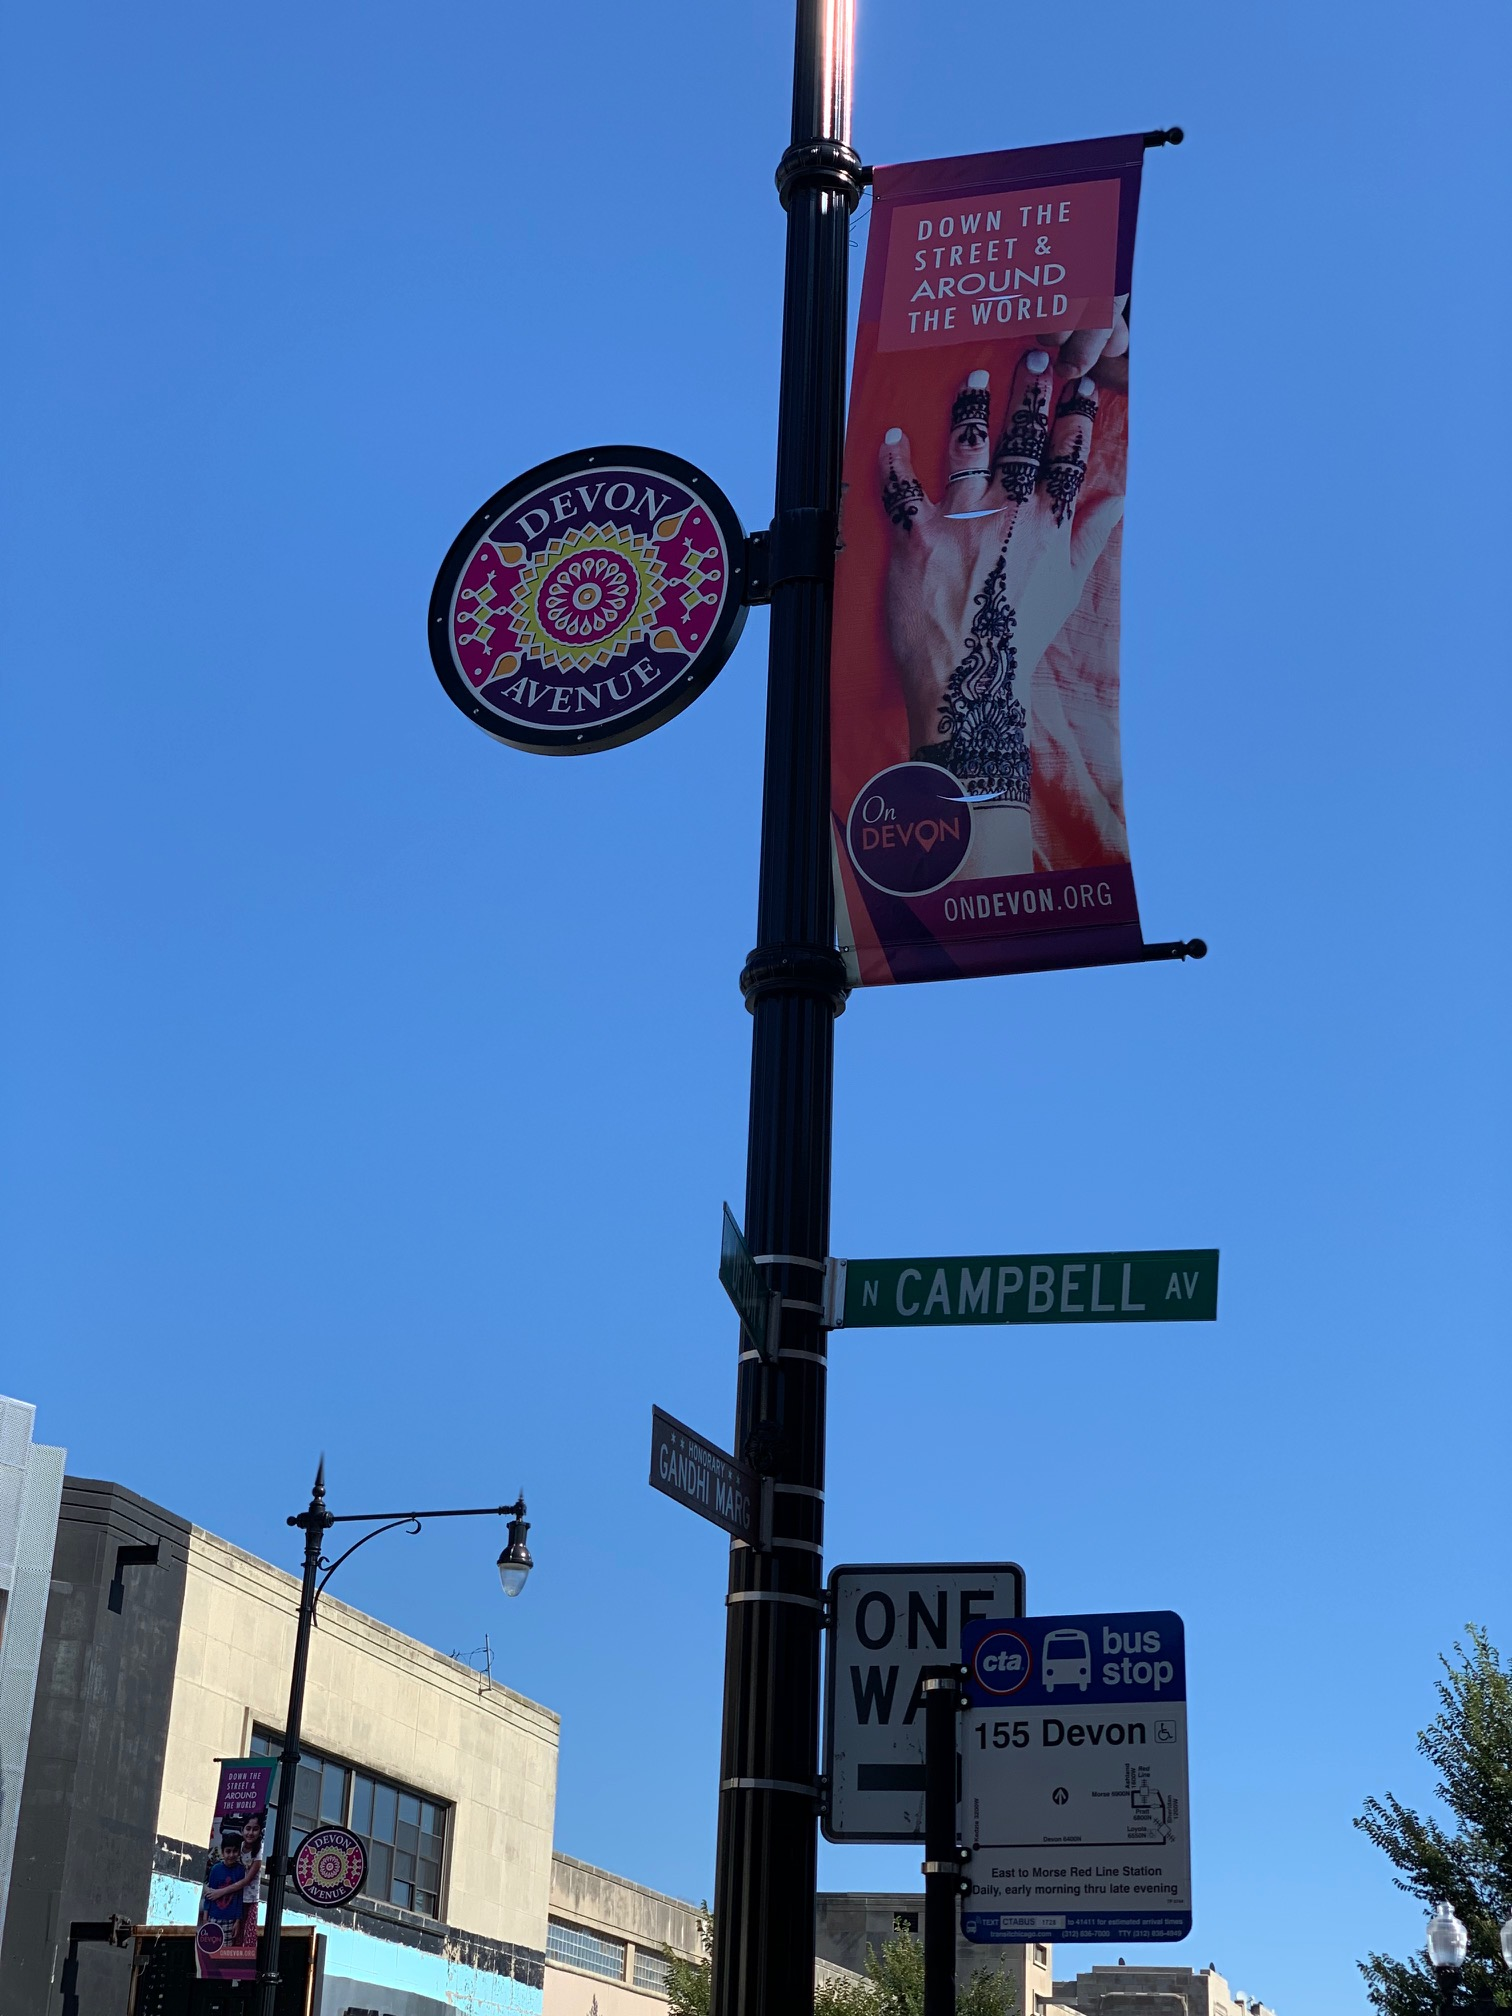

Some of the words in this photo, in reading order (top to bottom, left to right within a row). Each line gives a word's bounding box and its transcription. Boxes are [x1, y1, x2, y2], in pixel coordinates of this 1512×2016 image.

[917, 210, 1001, 241] DOWN
[1019, 201, 1071, 227] THE
[914, 237, 1018, 271] STREET
[1034, 235, 1052, 256] &
[910, 263, 1066, 302] AROUND
[908, 306, 956, 333] THE
[971, 294, 1068, 325] WORLD
[515, 482, 672, 542] DEVON
[501, 656, 662, 713] AVENUE
[862, 795, 896, 824] On
[862, 817, 960, 853] DEVON
[944, 882, 1113, 922] ONDEVON.ORG
[862, 1280, 878, 1307] N
[895, 1262, 1146, 1316] CAMPBELL
[1165, 1271, 1199, 1300] AV
[688, 1440, 726, 1478] HONORARY
[660, 1443, 710, 1505] GANDHI
[715, 1478, 751, 1530] MARG
[1102, 1626, 1161, 1655] bus
[983, 1652, 1022, 1672] cta
[1102, 1657, 1174, 1691] stop
[850, 1665, 928, 1725] WA
[975, 1721, 1030, 1750] 155
[1042, 1718, 1146, 1748] Devon
[226, 1782, 250, 1790] STREET
[228, 1772, 248, 1780] DOWN
[223, 1801, 234, 1810] THE
[236, 1800, 256, 1809] WORLD
[224, 1791, 258, 1800] AROUND
[314, 1834, 352, 1849] DEVON
[992, 1868, 1015, 1878] East
[1018, 1868, 1029, 1877] to
[1032, 1867, 1066, 1877] Morse
[1070, 1866, 1092, 1876] Red
[1096, 1866, 1119, 1876] Line
[1122, 1866, 1162, 1876] Station
[308, 1885, 346, 1900] AVENUE
[972, 1884, 1002, 1897] Daily,
[1005, 1884, 1032, 1897] early
[1035, 1884, 1080, 1896] morning
[1084, 1884, 1106, 1894] thru
[1110, 1883, 1130, 1894] late
[1134, 1883, 1178, 1896] evening
[1002, 1918, 1036, 1926] CTABUS
